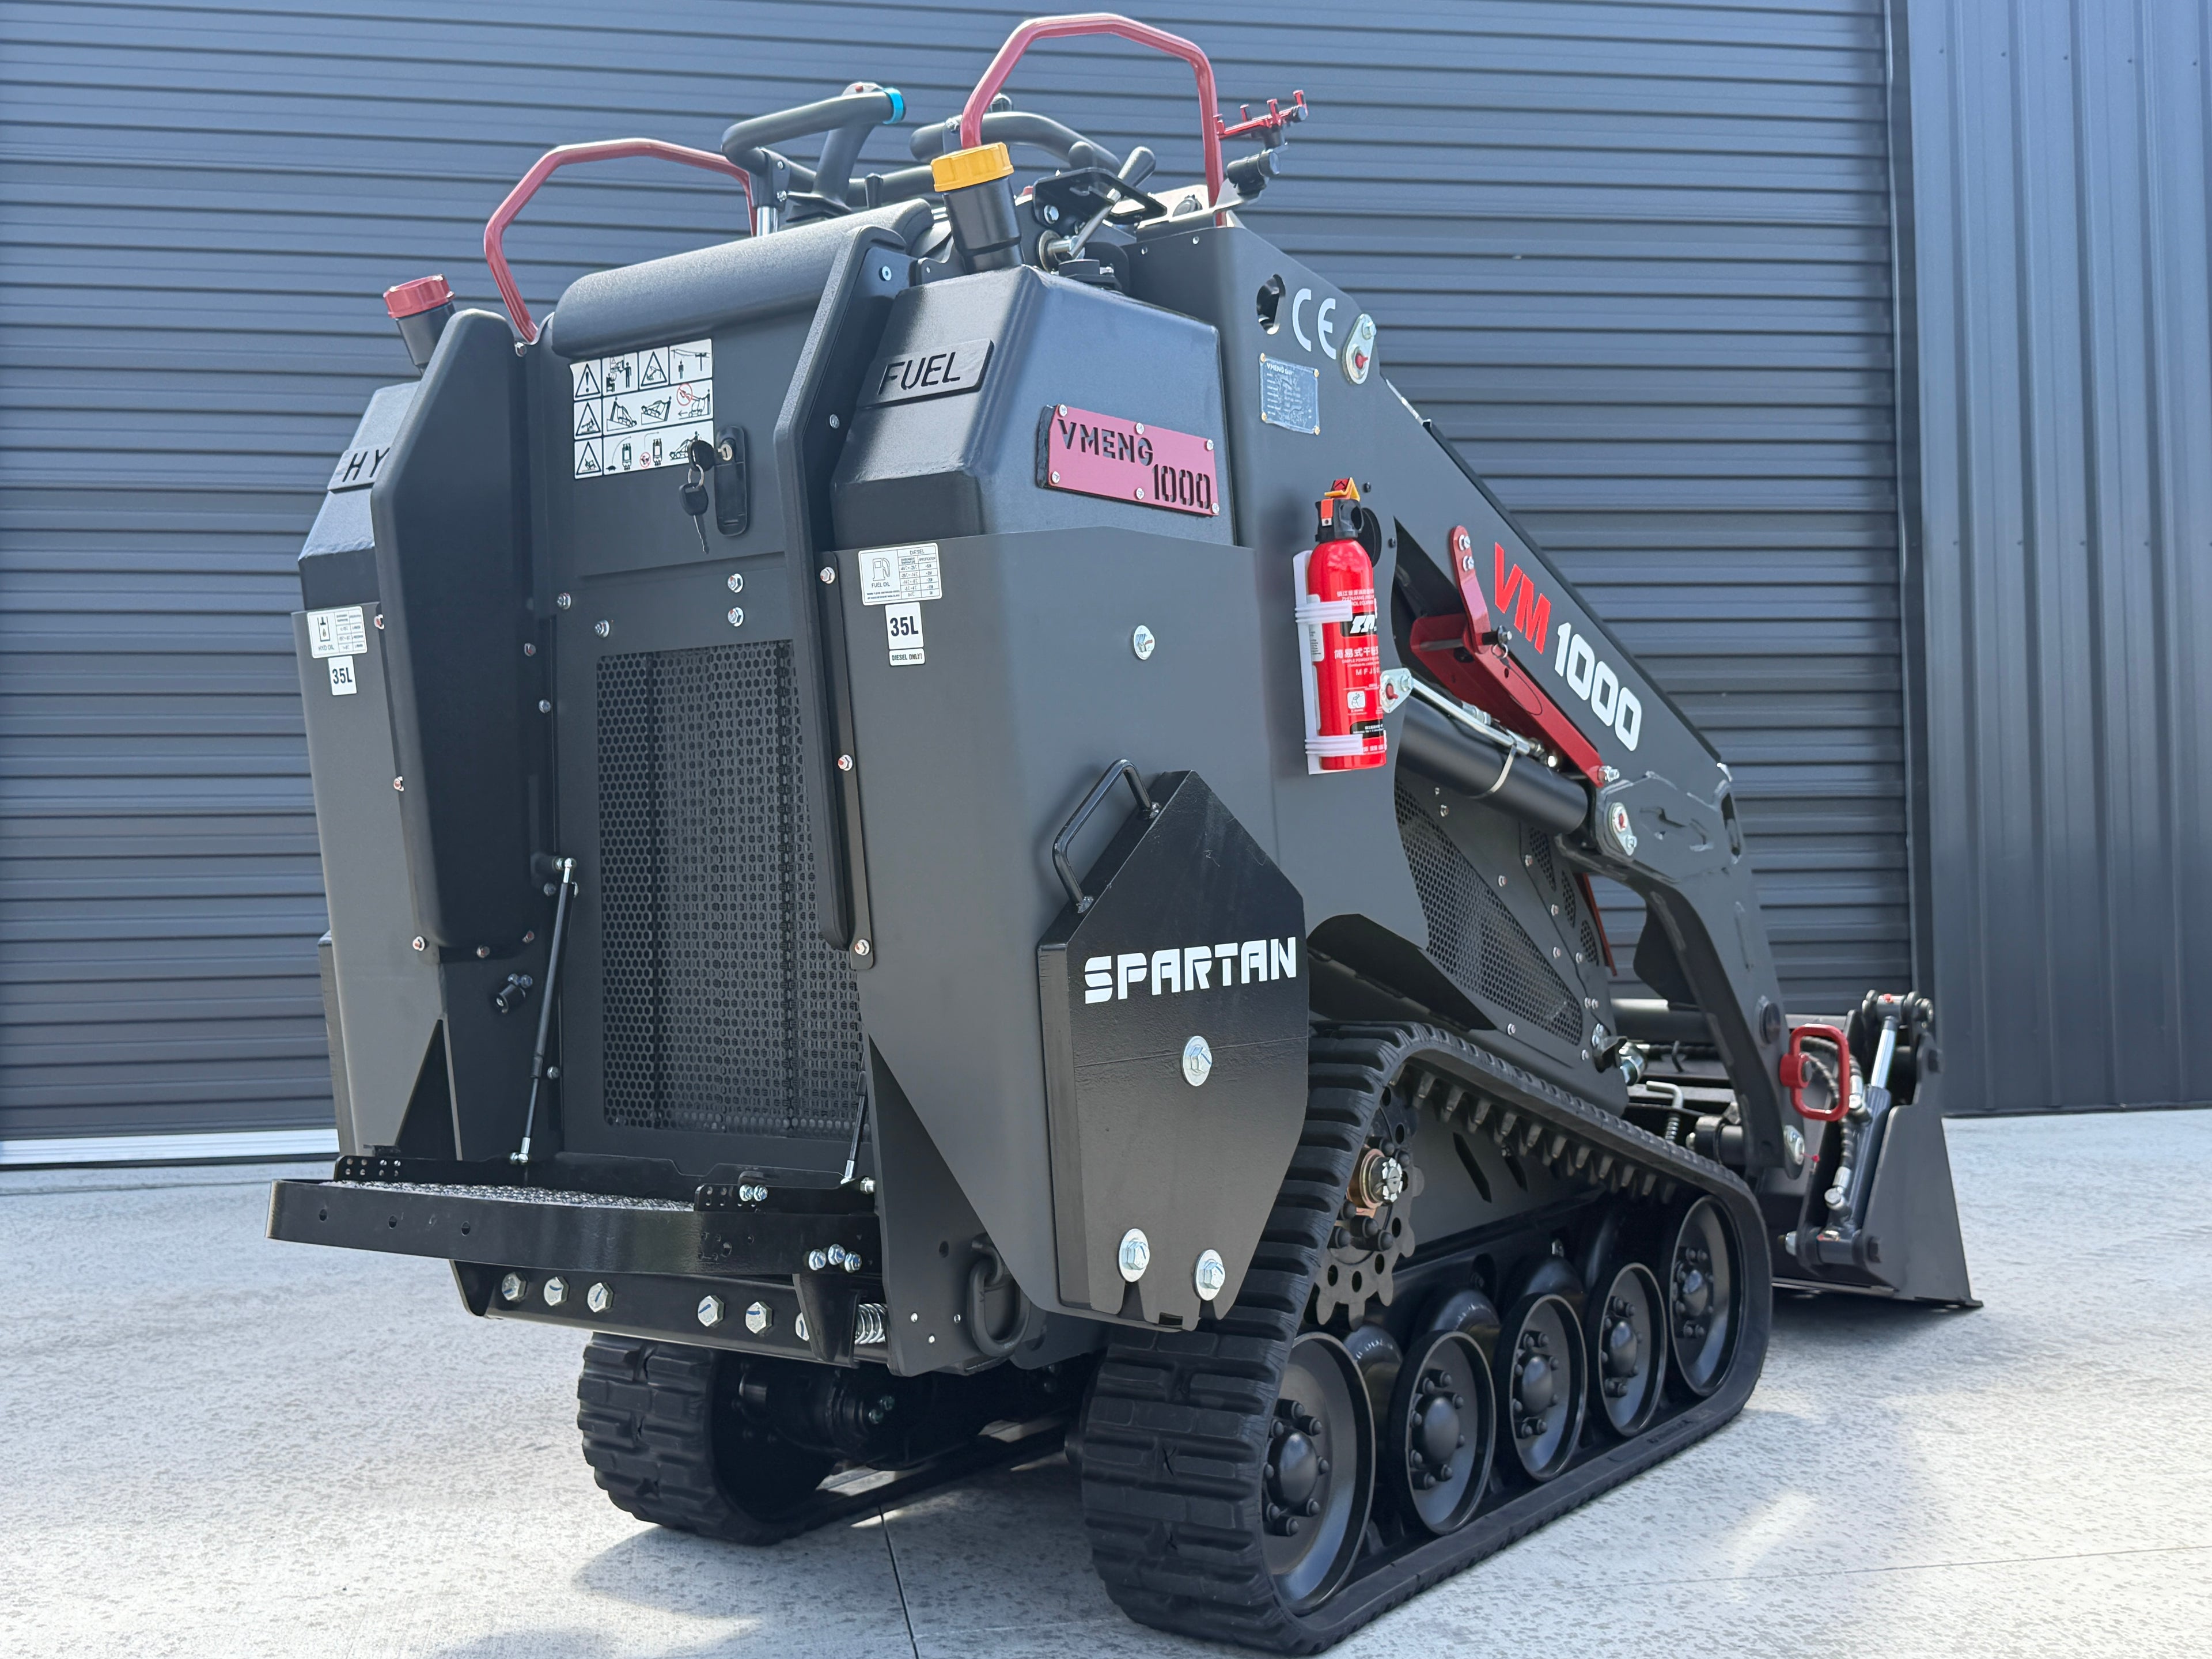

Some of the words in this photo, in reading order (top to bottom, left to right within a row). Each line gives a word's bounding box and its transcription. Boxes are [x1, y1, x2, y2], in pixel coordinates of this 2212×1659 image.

[1292, 288, 1336, 359] CE
[877, 351, 961, 395] FUEL
[1057, 419, 1153, 466] VMENG
[1152, 464, 1211, 509] 1000
[890, 616, 919, 637] 35L
[1495, 541, 1551, 654] VM
[1555, 622, 1642, 751] 1000
[332, 667, 353, 684] 35L
[1085, 937, 1297, 1005] SPARTAN
